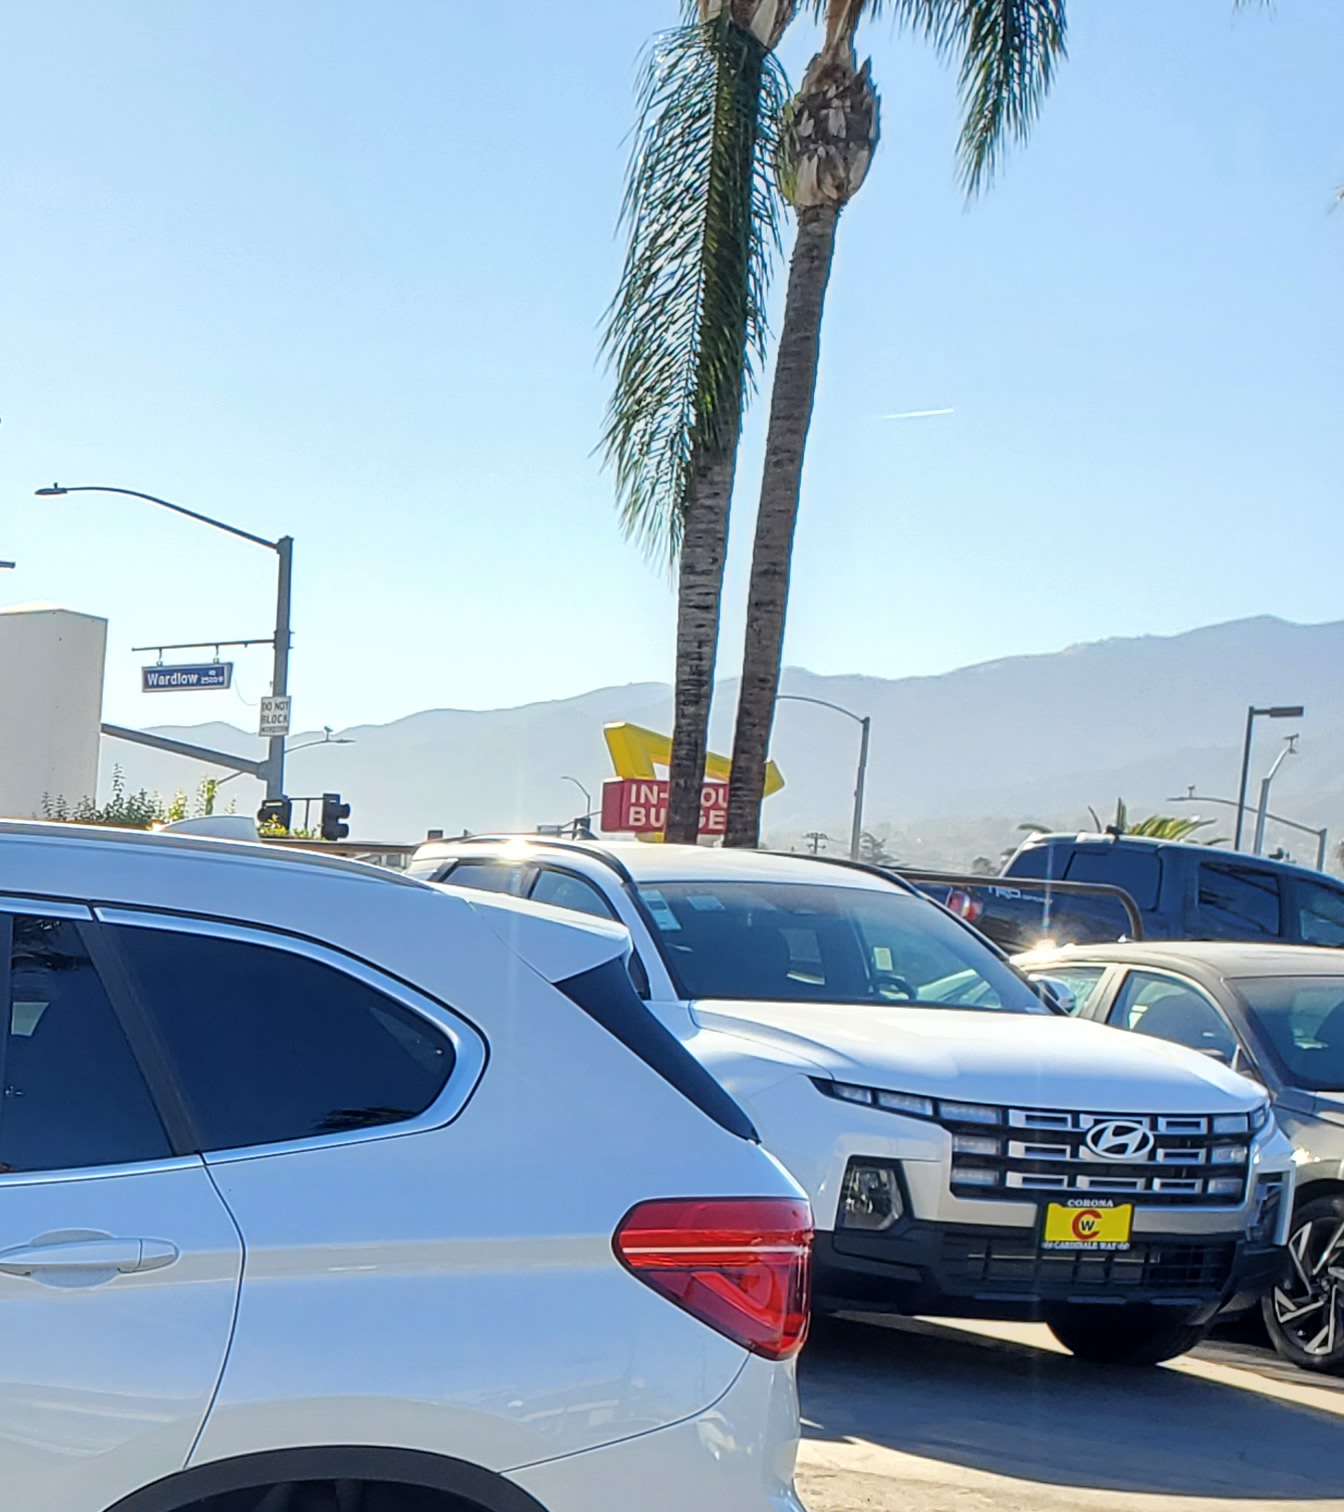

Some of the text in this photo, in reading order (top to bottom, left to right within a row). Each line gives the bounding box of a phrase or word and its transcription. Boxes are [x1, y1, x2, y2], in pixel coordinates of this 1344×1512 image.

[147, 672, 199, 687] Wardlow
[262, 700, 289, 712] DO NOT
[261, 713, 289, 724] BLOCK
[630, 783, 729, 809] IN-OU
[628, 805, 725, 830] BUE
[1067, 1199, 1114, 1208] CORONA
[1054, 1241, 1117, 1251] CARDINALE WAY
